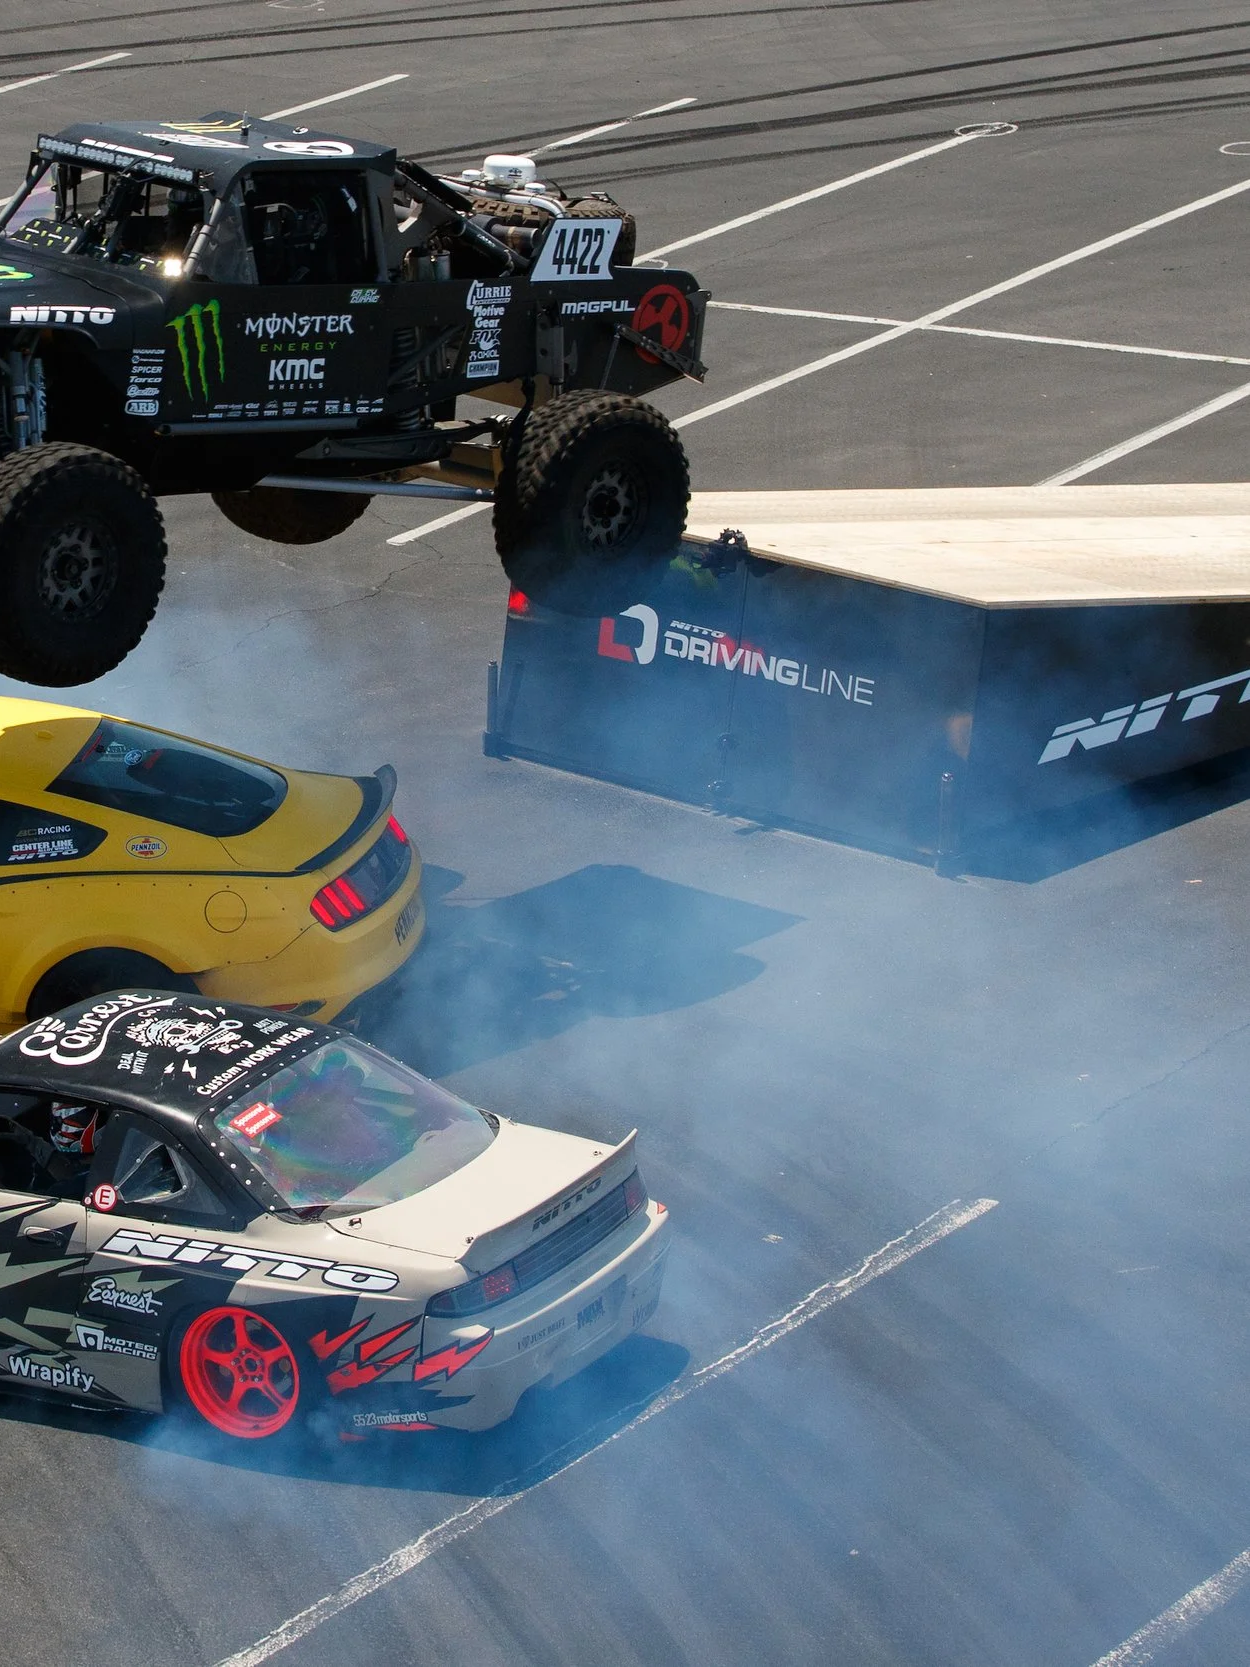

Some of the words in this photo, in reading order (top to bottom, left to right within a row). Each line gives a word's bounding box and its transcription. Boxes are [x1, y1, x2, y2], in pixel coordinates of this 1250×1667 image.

[552, 229, 603, 275] 4422
[10, 305, 116, 325] NITTO
[473, 305, 505, 317] Motive
[561, 300, 636, 315] MAGPUL
[245, 313, 354, 338] MONSTER
[475, 317, 500, 328] Gear
[469, 329, 502, 345] FOX
[260, 342, 338, 352] ENERGY
[269, 359, 326, 381] KMC
[130, 375, 162, 383] Torco
[268, 382, 324, 390] WHEELS
[129, 402, 156, 413] ARB
[670, 620, 726, 639] NITTO
[38, 825, 71, 835] RACING
[12, 841, 49, 852] CENTER
[52, 839, 73, 849] LINE
[131, 843, 161, 852] PENNZOIL
[8, 849, 78, 862] NITTO
[117, 1052, 134, 1070] DEAL
[196, 1066, 242, 1096] Custom
[236, 1044, 282, 1068] WORK
[271, 1027, 314, 1047] WEAR
[103, 1229, 399, 1291] NITTO
[103, 1343, 157, 1360] RACING
[104, 1336, 158, 1353] MOTEGI
[9, 1355, 94, 1392] Wrapify
[376, 1410, 427, 1425] motorsports
